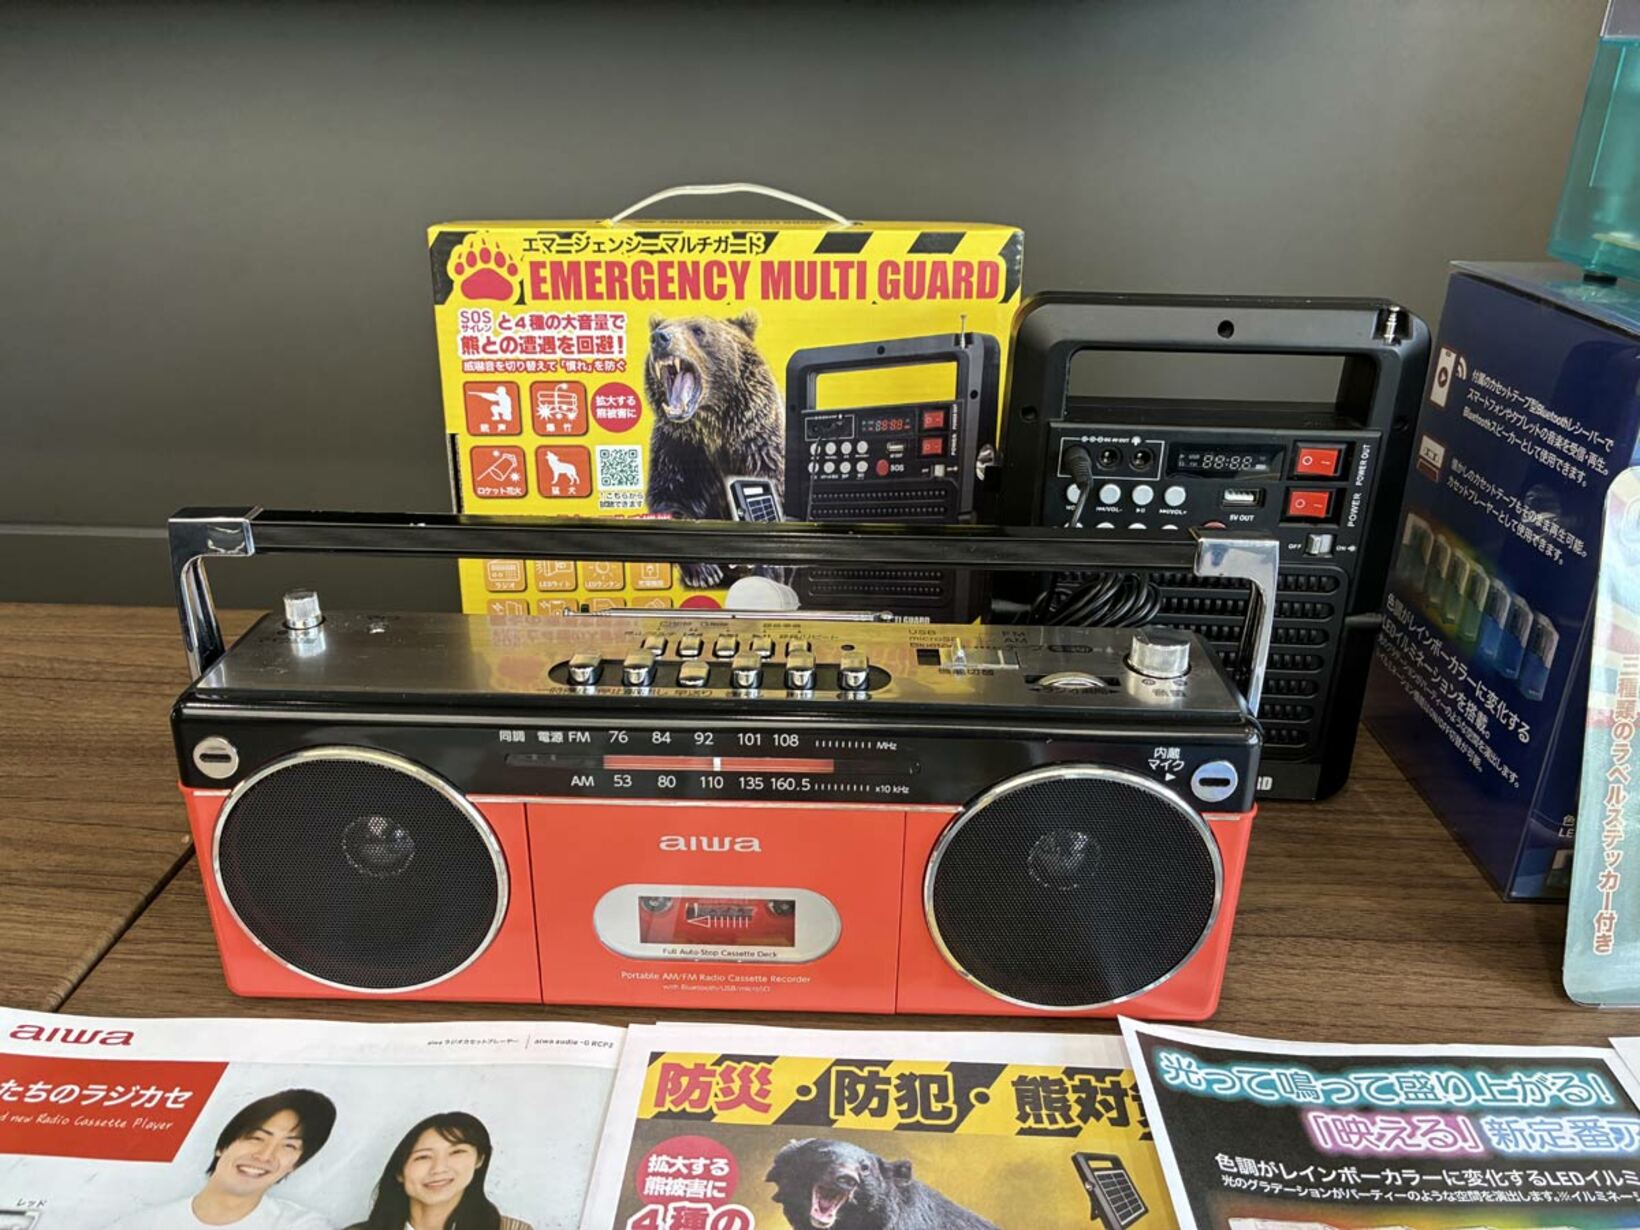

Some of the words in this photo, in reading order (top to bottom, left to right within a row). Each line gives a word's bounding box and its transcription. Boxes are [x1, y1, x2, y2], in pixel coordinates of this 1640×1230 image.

[523, 235, 765, 253] エマージェンシーマルチガード
[530, 261, 750, 300] EMERGENCY
[761, 260, 867, 300] MULTI
[878, 259, 1000, 300] GUARD
[460, 310, 492, 324] SOS
[498, 313, 625, 331] と4種の大音量で
[1347, 493, 1362, 527] POWER
[568, 732, 591, 742] FM
[609, 731, 629, 743] 76
[652, 732, 672, 744] 84
[694, 732, 714, 744] 92
[737, 733, 761, 745] 101
[772, 734, 799, 746] 108
[1148, 759, 1185, 771] マイク
[570, 776, 595, 787] AM
[613, 775, 632, 787] 53
[657, 776, 676, 788] 80
[700, 776, 724, 788] 110
[738, 777, 764, 790] 135
[770, 778, 811, 791] 160.5
[659, 835, 762, 853] aiwa
[701, 949, 719, 957] Stop
[721, 950, 754, 958] Cassette
[621, 971, 659, 980] Portable
[662, 971, 697, 981] AM/FM
[700, 973, 725, 982] Radio
[728, 974, 767, 983] Cassette
[770, 975, 811, 983] Recorder
[10, 1023, 135, 1046] aiwa
[1161, 1053, 1613, 1105] 光って鳴って盛り上がる!
[0, 1079, 193, 1109] たちのラジカセ
[36, 1113, 70, 1126] Radio
[74, 1115, 127, 1128] Cassette
[132, 1117, 174, 1131] Player
[647, 1154, 730, 1176] 拡大する
[643, 1175, 727, 1199] 熊被害に
